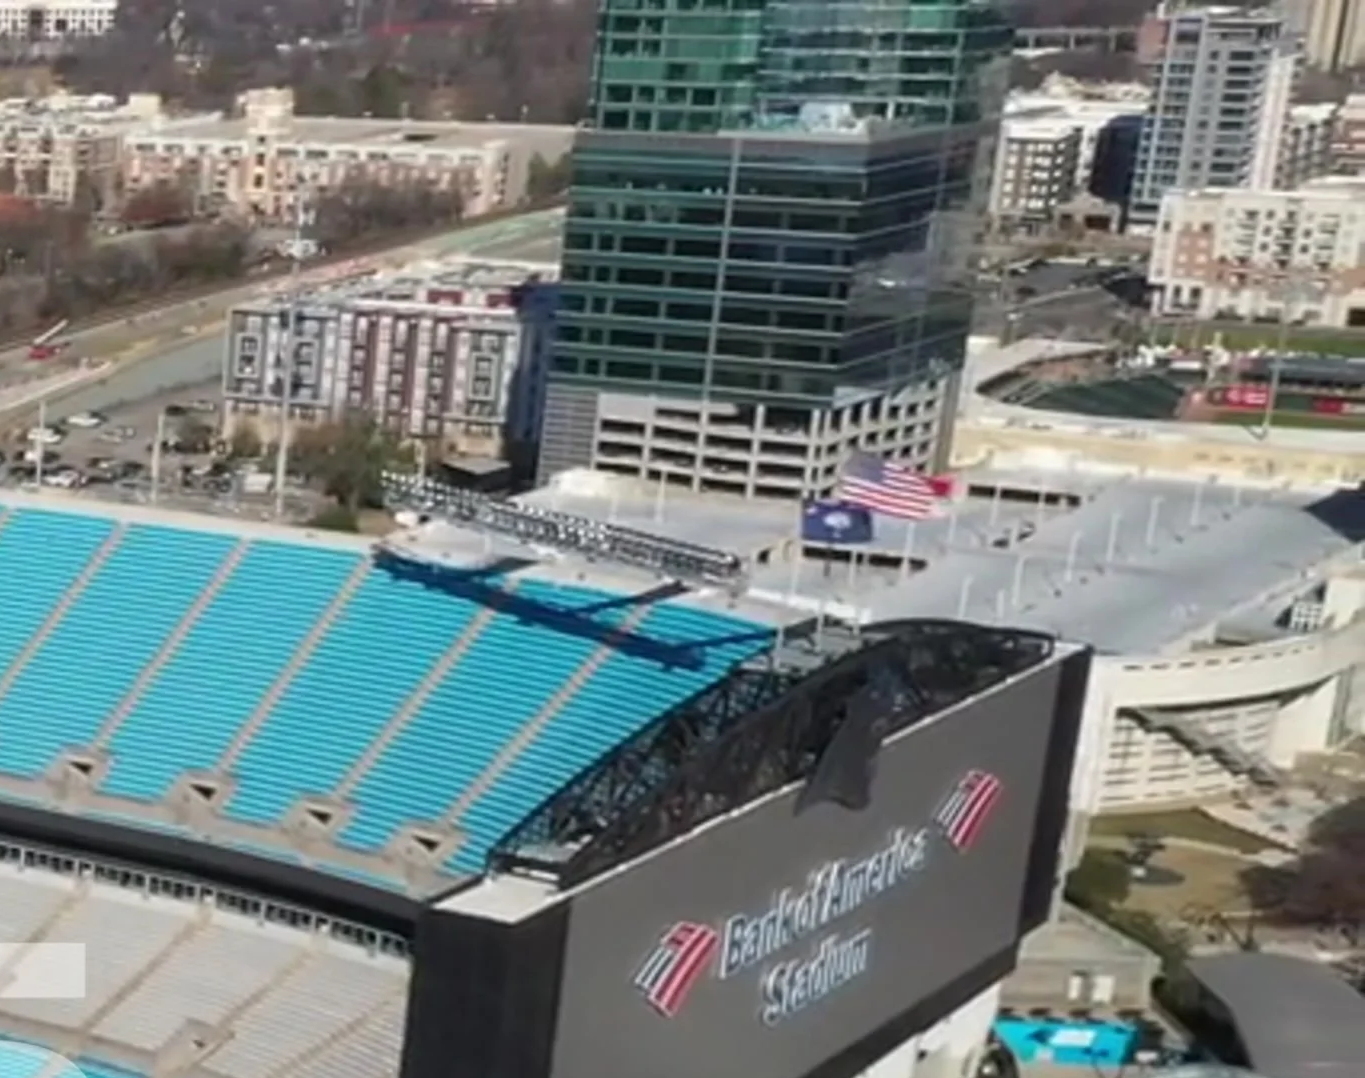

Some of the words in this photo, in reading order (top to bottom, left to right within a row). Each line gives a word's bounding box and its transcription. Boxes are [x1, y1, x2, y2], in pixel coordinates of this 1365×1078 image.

[719, 887, 795, 980] Bank
[820, 826, 930, 925] America
[762, 927, 873, 1028] Stadium
